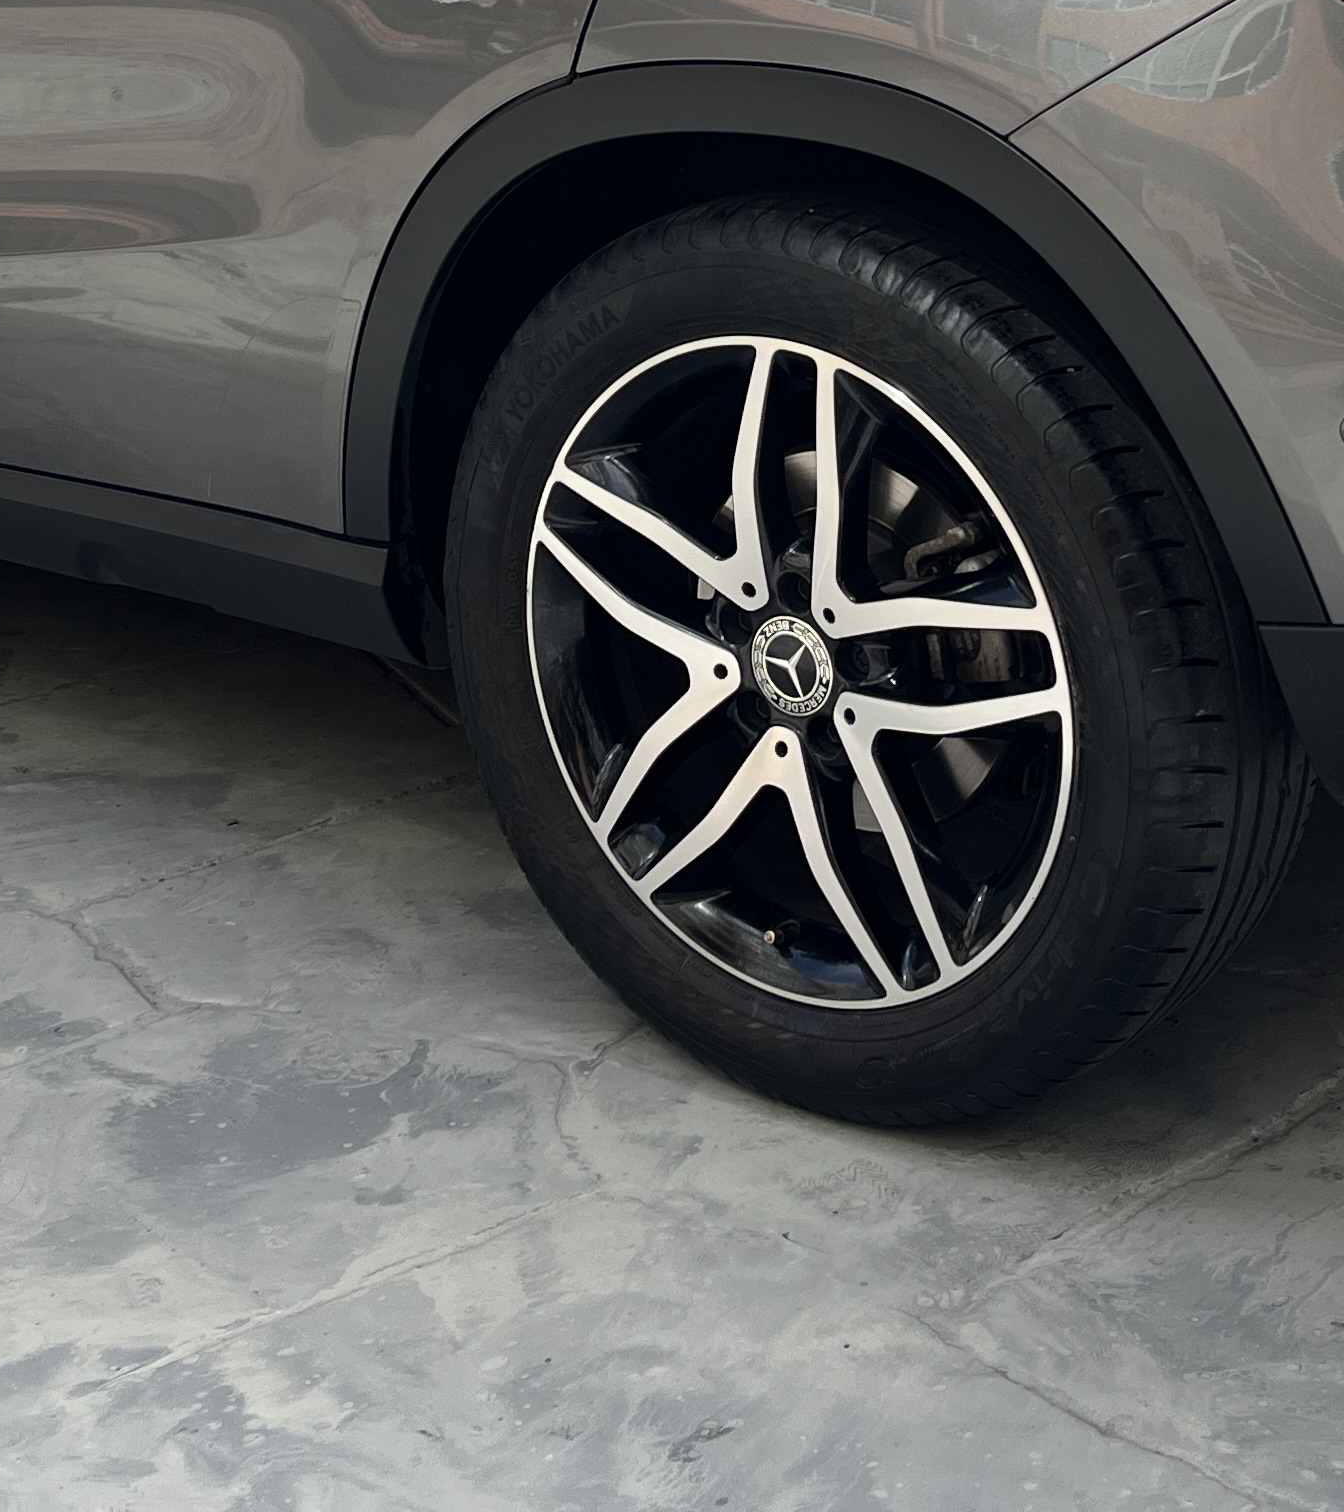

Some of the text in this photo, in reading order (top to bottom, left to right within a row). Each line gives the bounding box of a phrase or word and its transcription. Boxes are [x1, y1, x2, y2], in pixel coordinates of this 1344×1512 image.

[506, 304, 621, 422] YOKOHAMA
[763, 620, 790, 638] BENZ
[778, 684, 828, 713] MERCEDES
